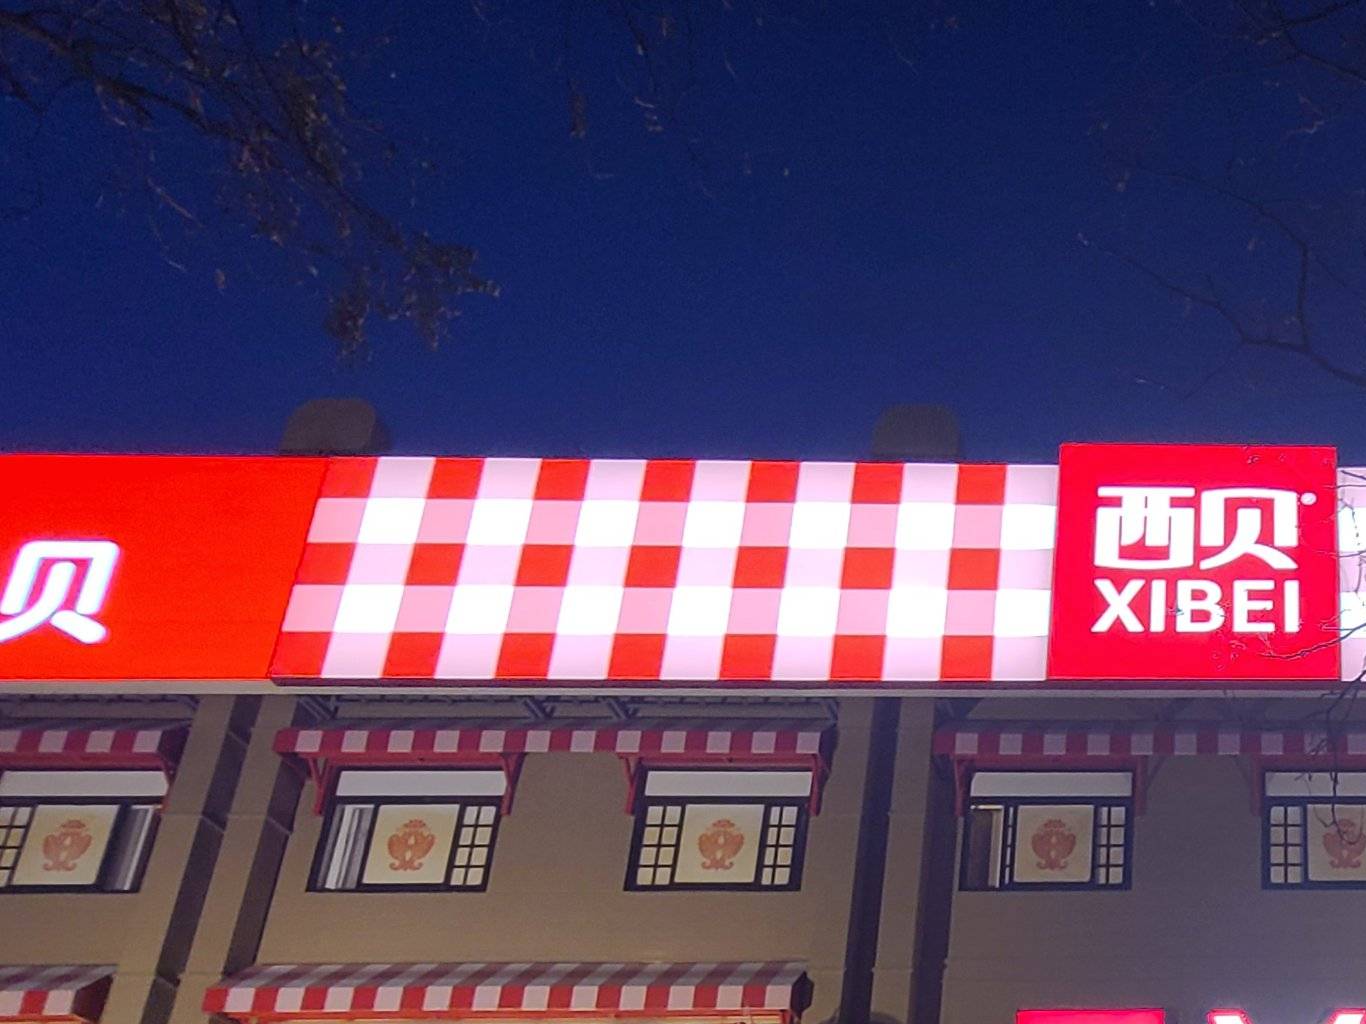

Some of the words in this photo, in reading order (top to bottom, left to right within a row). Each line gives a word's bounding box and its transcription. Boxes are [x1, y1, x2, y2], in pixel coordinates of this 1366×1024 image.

[1093, 486, 1299, 570] 西贝
[0, 540, 120, 645] 贝
[1090, 578, 1301, 633] XIBEI
